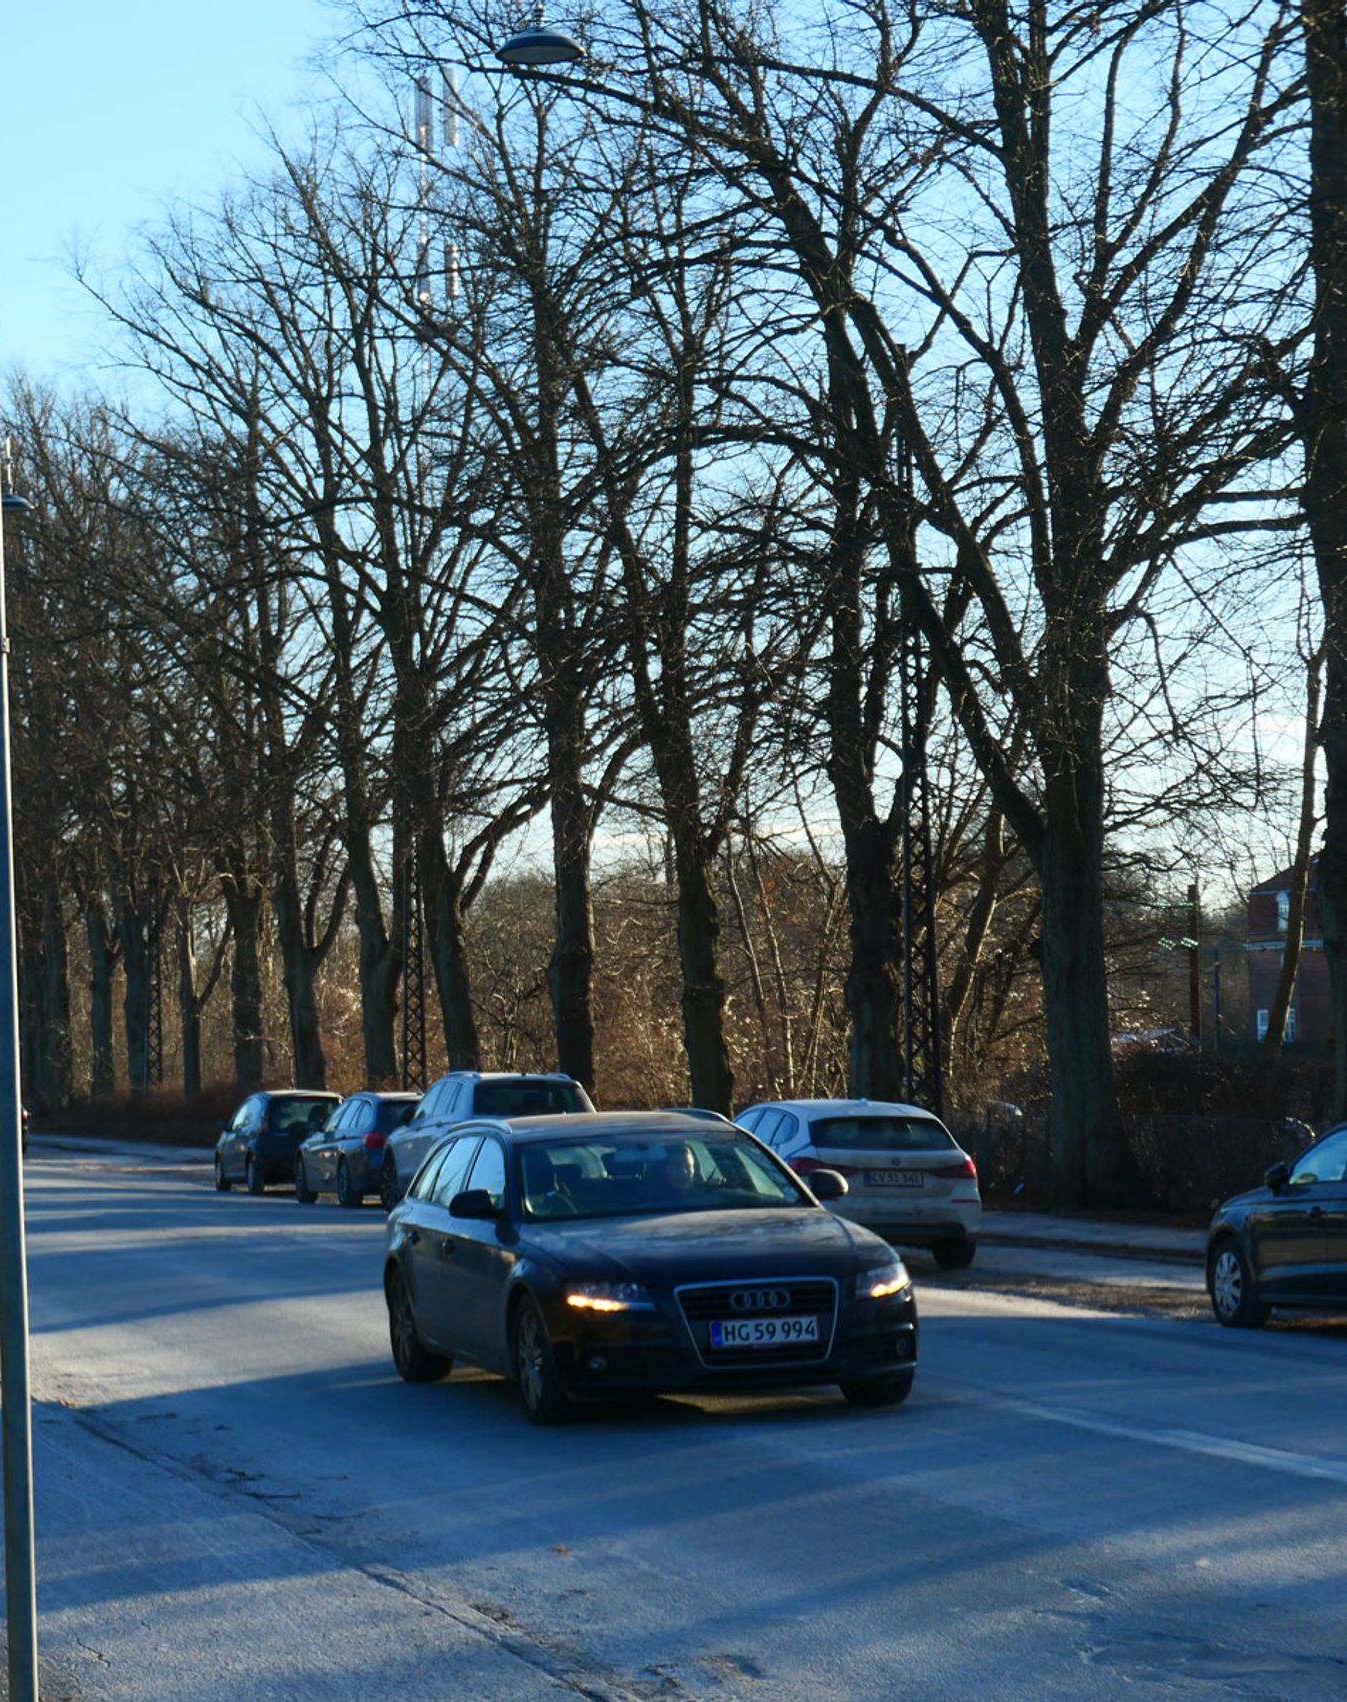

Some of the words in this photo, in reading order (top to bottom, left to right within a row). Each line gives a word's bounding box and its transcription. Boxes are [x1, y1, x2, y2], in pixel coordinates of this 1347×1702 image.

[724, 1323, 751, 1342] HG
[754, 1321, 777, 1341] 59
[780, 1319, 816, 1340] 994
